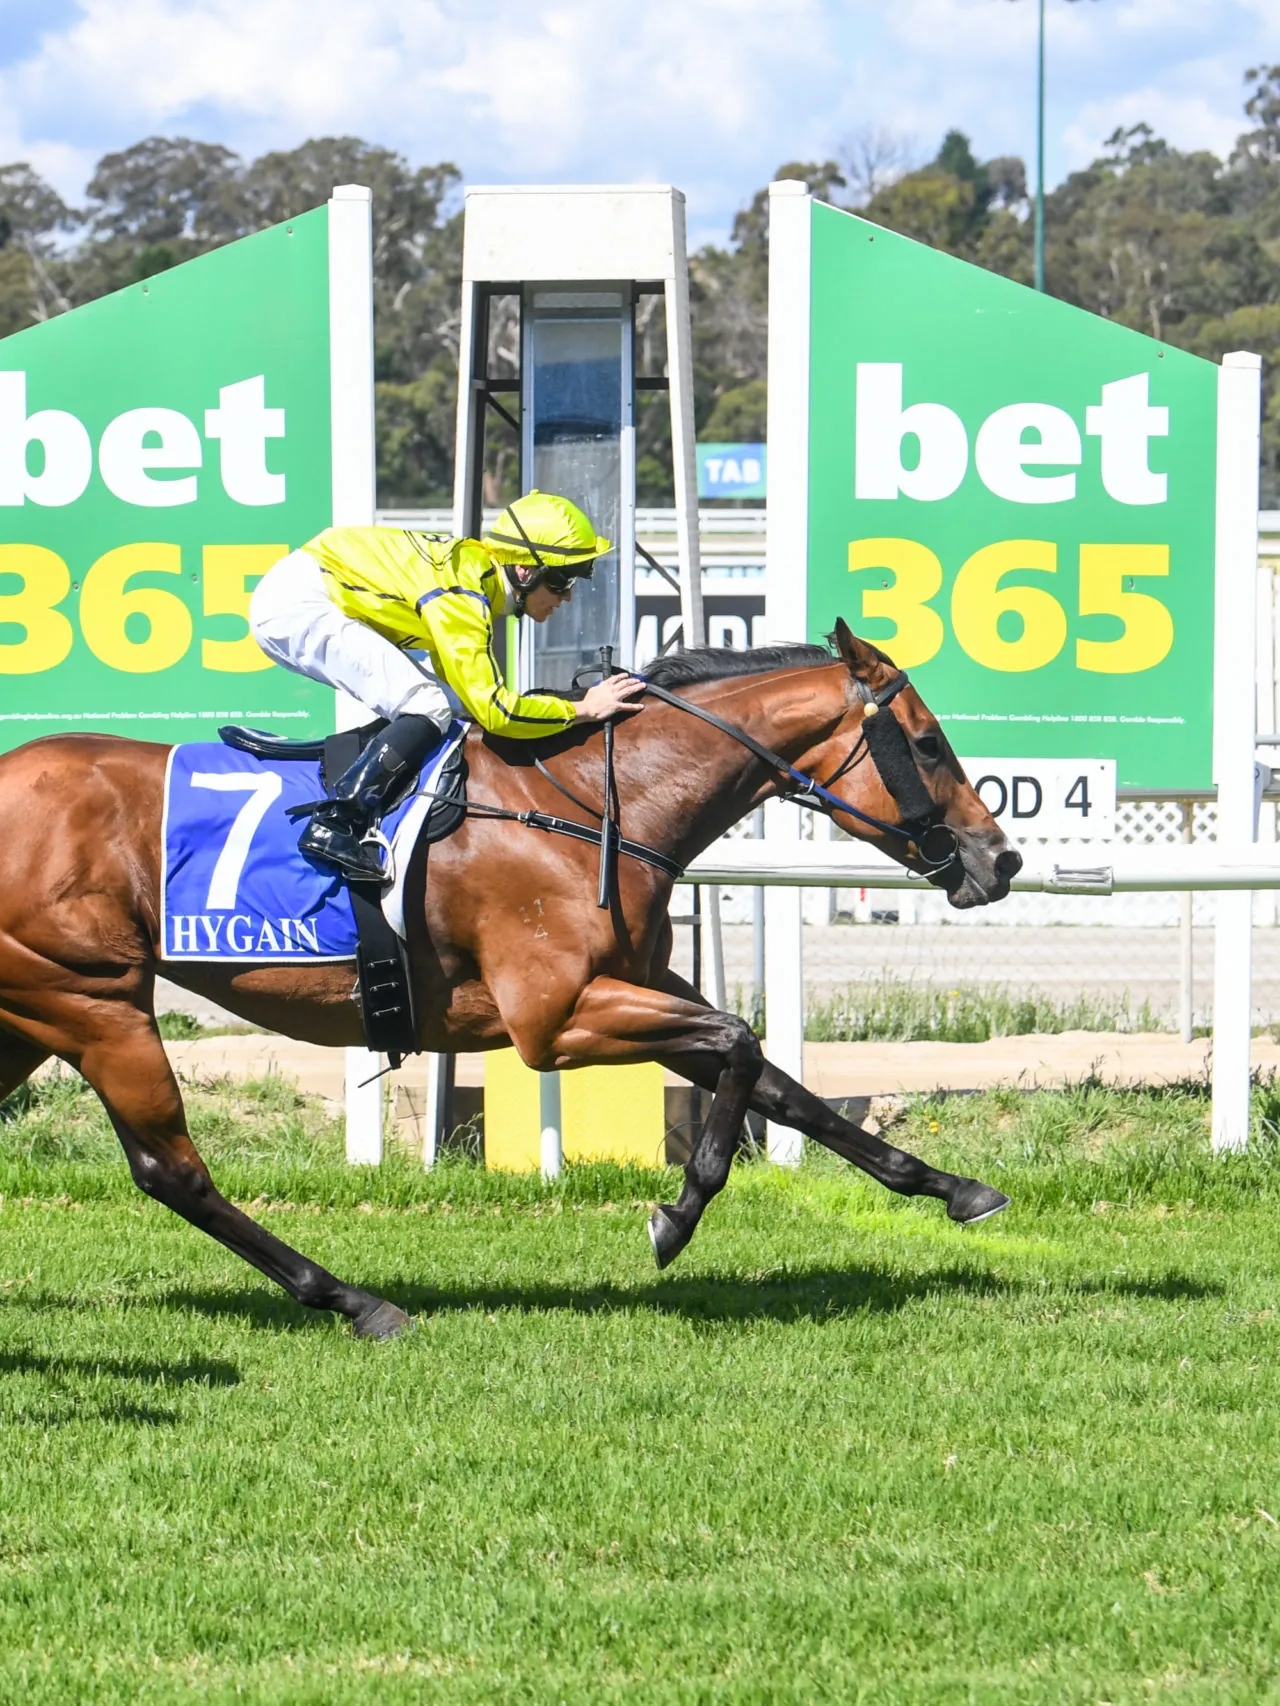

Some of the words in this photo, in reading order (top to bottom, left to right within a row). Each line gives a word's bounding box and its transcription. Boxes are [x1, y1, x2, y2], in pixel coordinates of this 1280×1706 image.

[705, 459, 762, 484] TAB
[855, 363, 1169, 505] bet
[848, 537, 1174, 674] 365
[190, 771, 282, 910] 7
[1065, 776, 1092, 817] 4
[172, 914, 320, 953] HYGAIN
